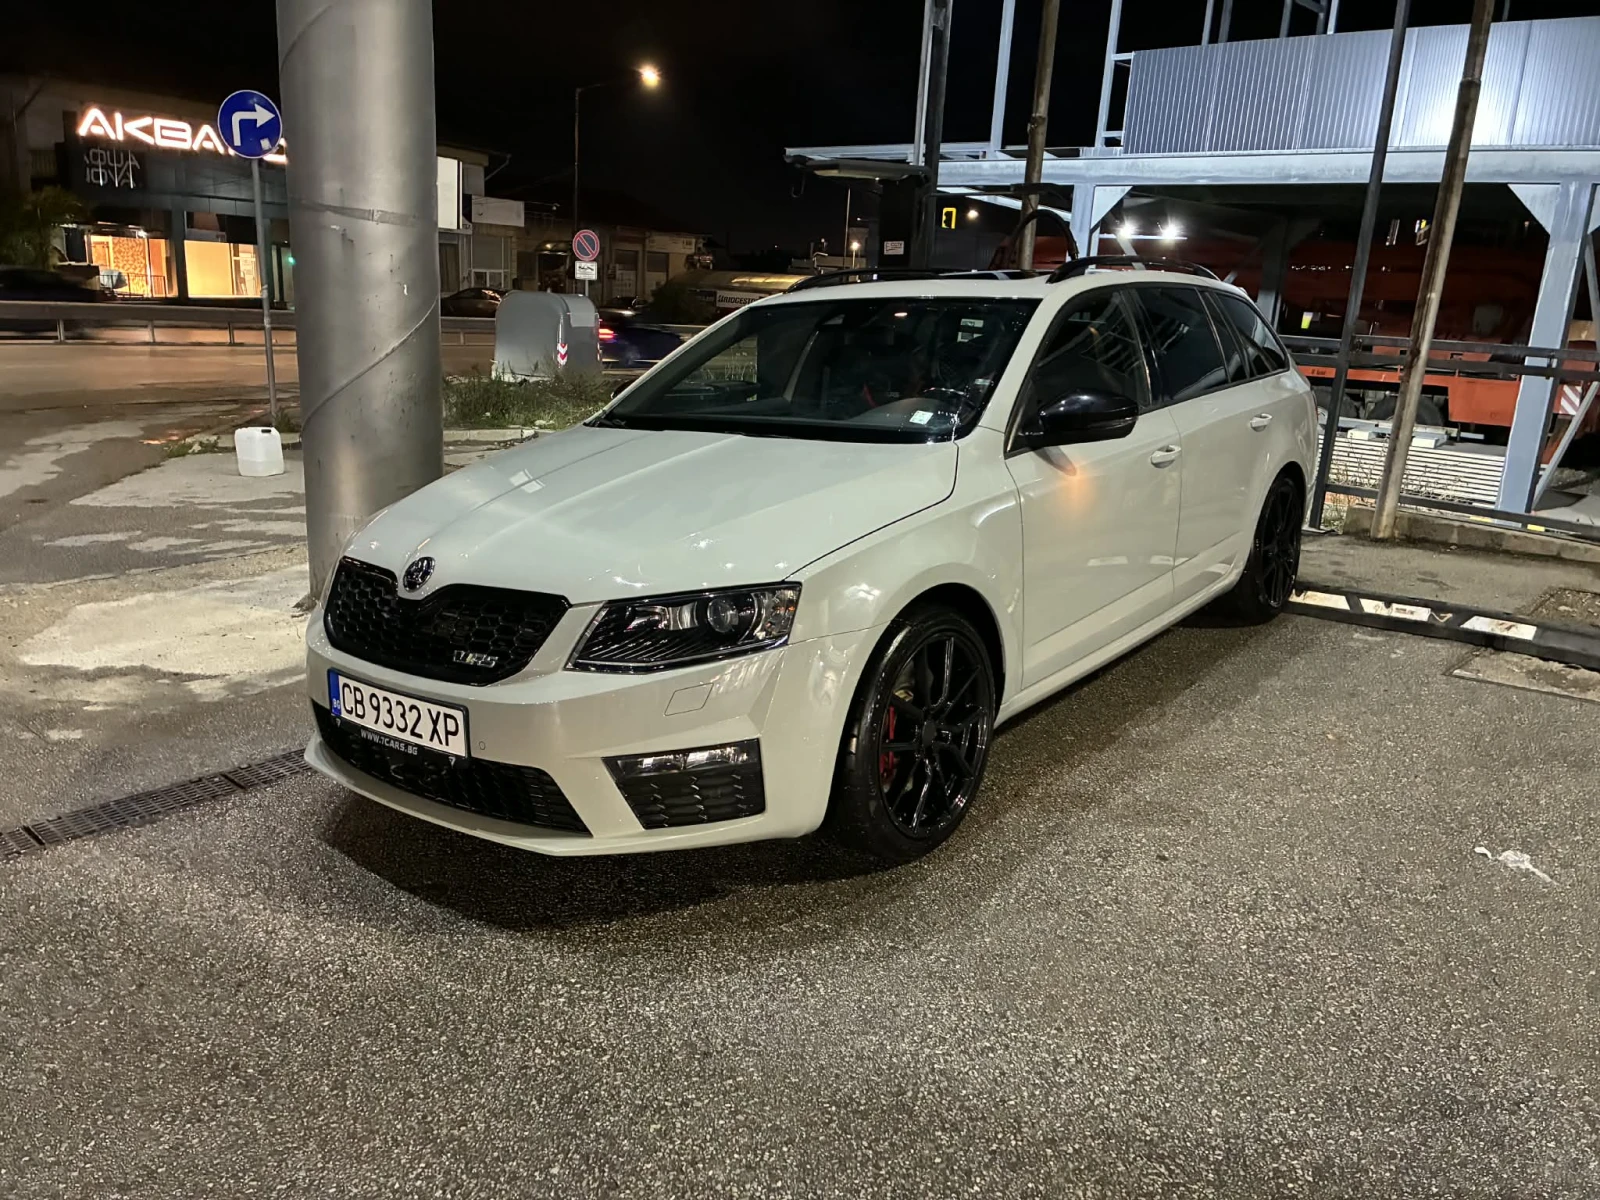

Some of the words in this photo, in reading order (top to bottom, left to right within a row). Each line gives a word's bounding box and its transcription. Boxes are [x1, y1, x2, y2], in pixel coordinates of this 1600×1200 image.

[341, 682, 366, 719] CB
[369, 692, 424, 739] 9332
[428, 708, 460, 747] XP
